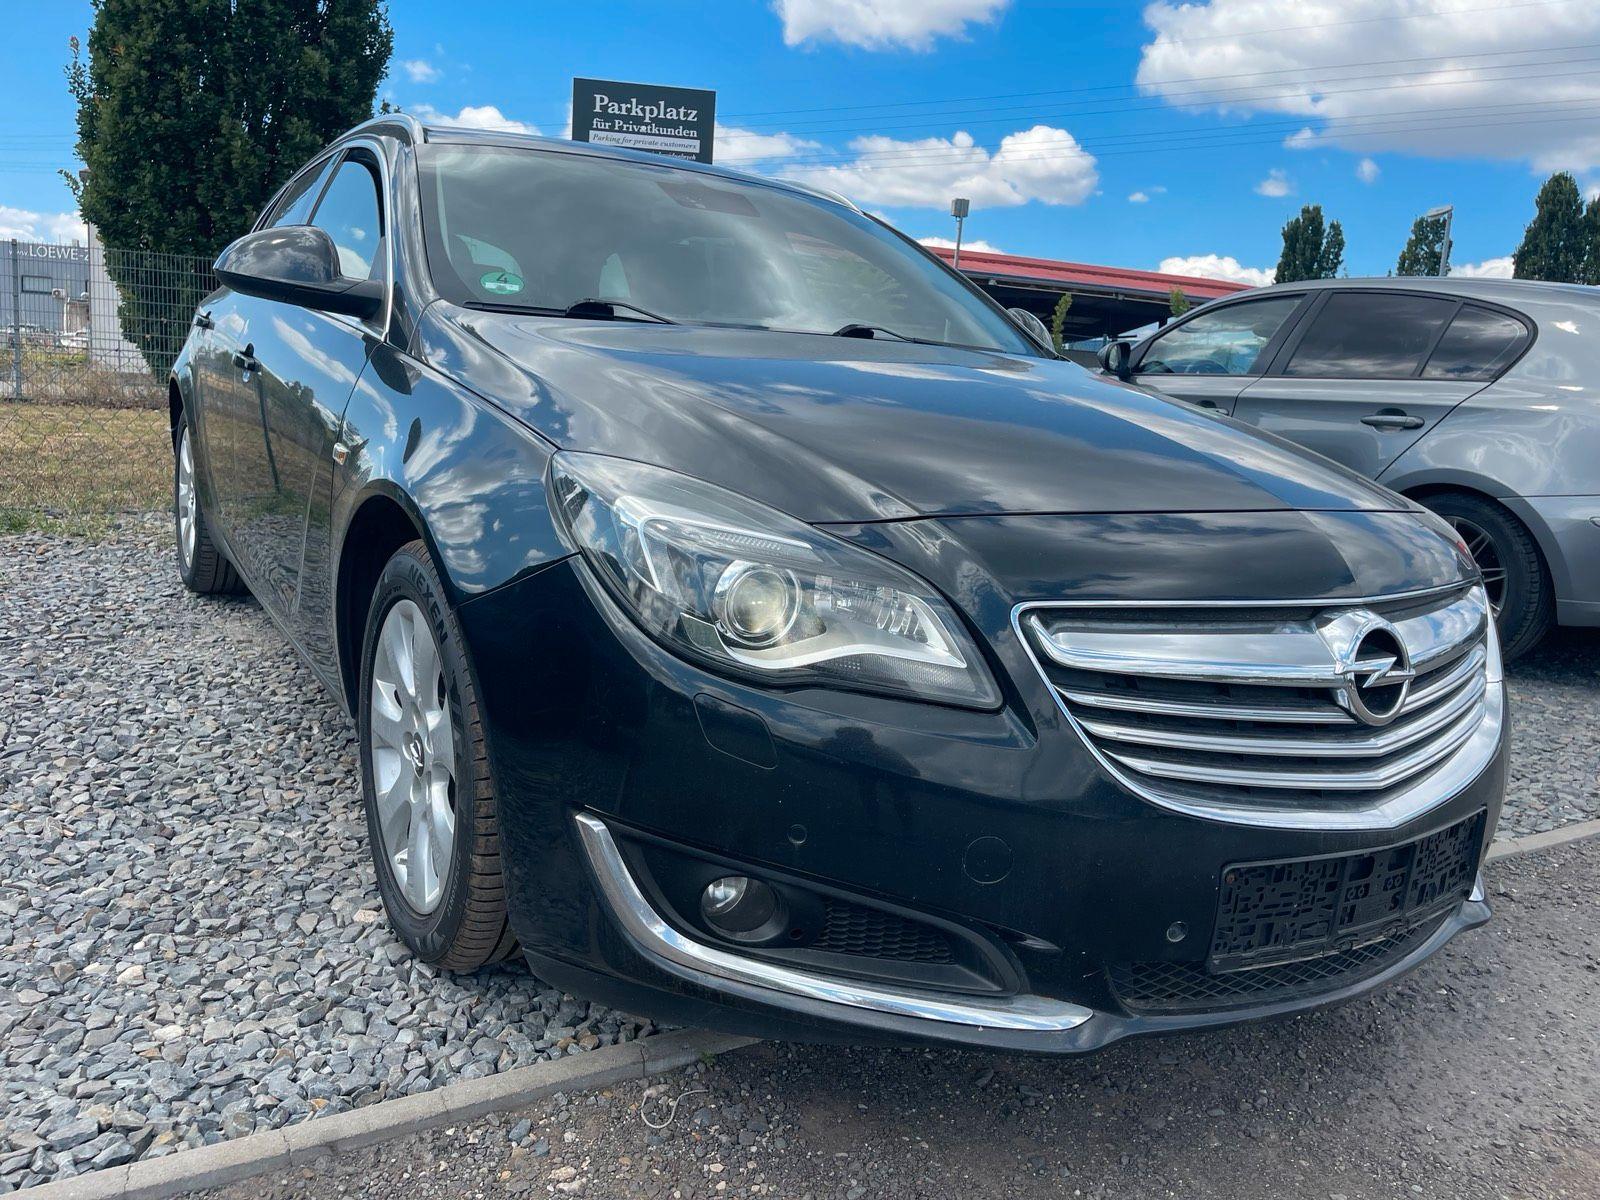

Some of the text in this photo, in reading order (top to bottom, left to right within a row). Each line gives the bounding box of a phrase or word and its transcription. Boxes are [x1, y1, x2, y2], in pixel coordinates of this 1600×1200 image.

[593, 94, 698, 123] Parkplatz
[592, 118, 698, 138] für Privatkunden
[592, 133, 697, 150] Parking for private customers
[496, 272, 508, 284] 4
[408, 564, 449, 646] NEXEN
